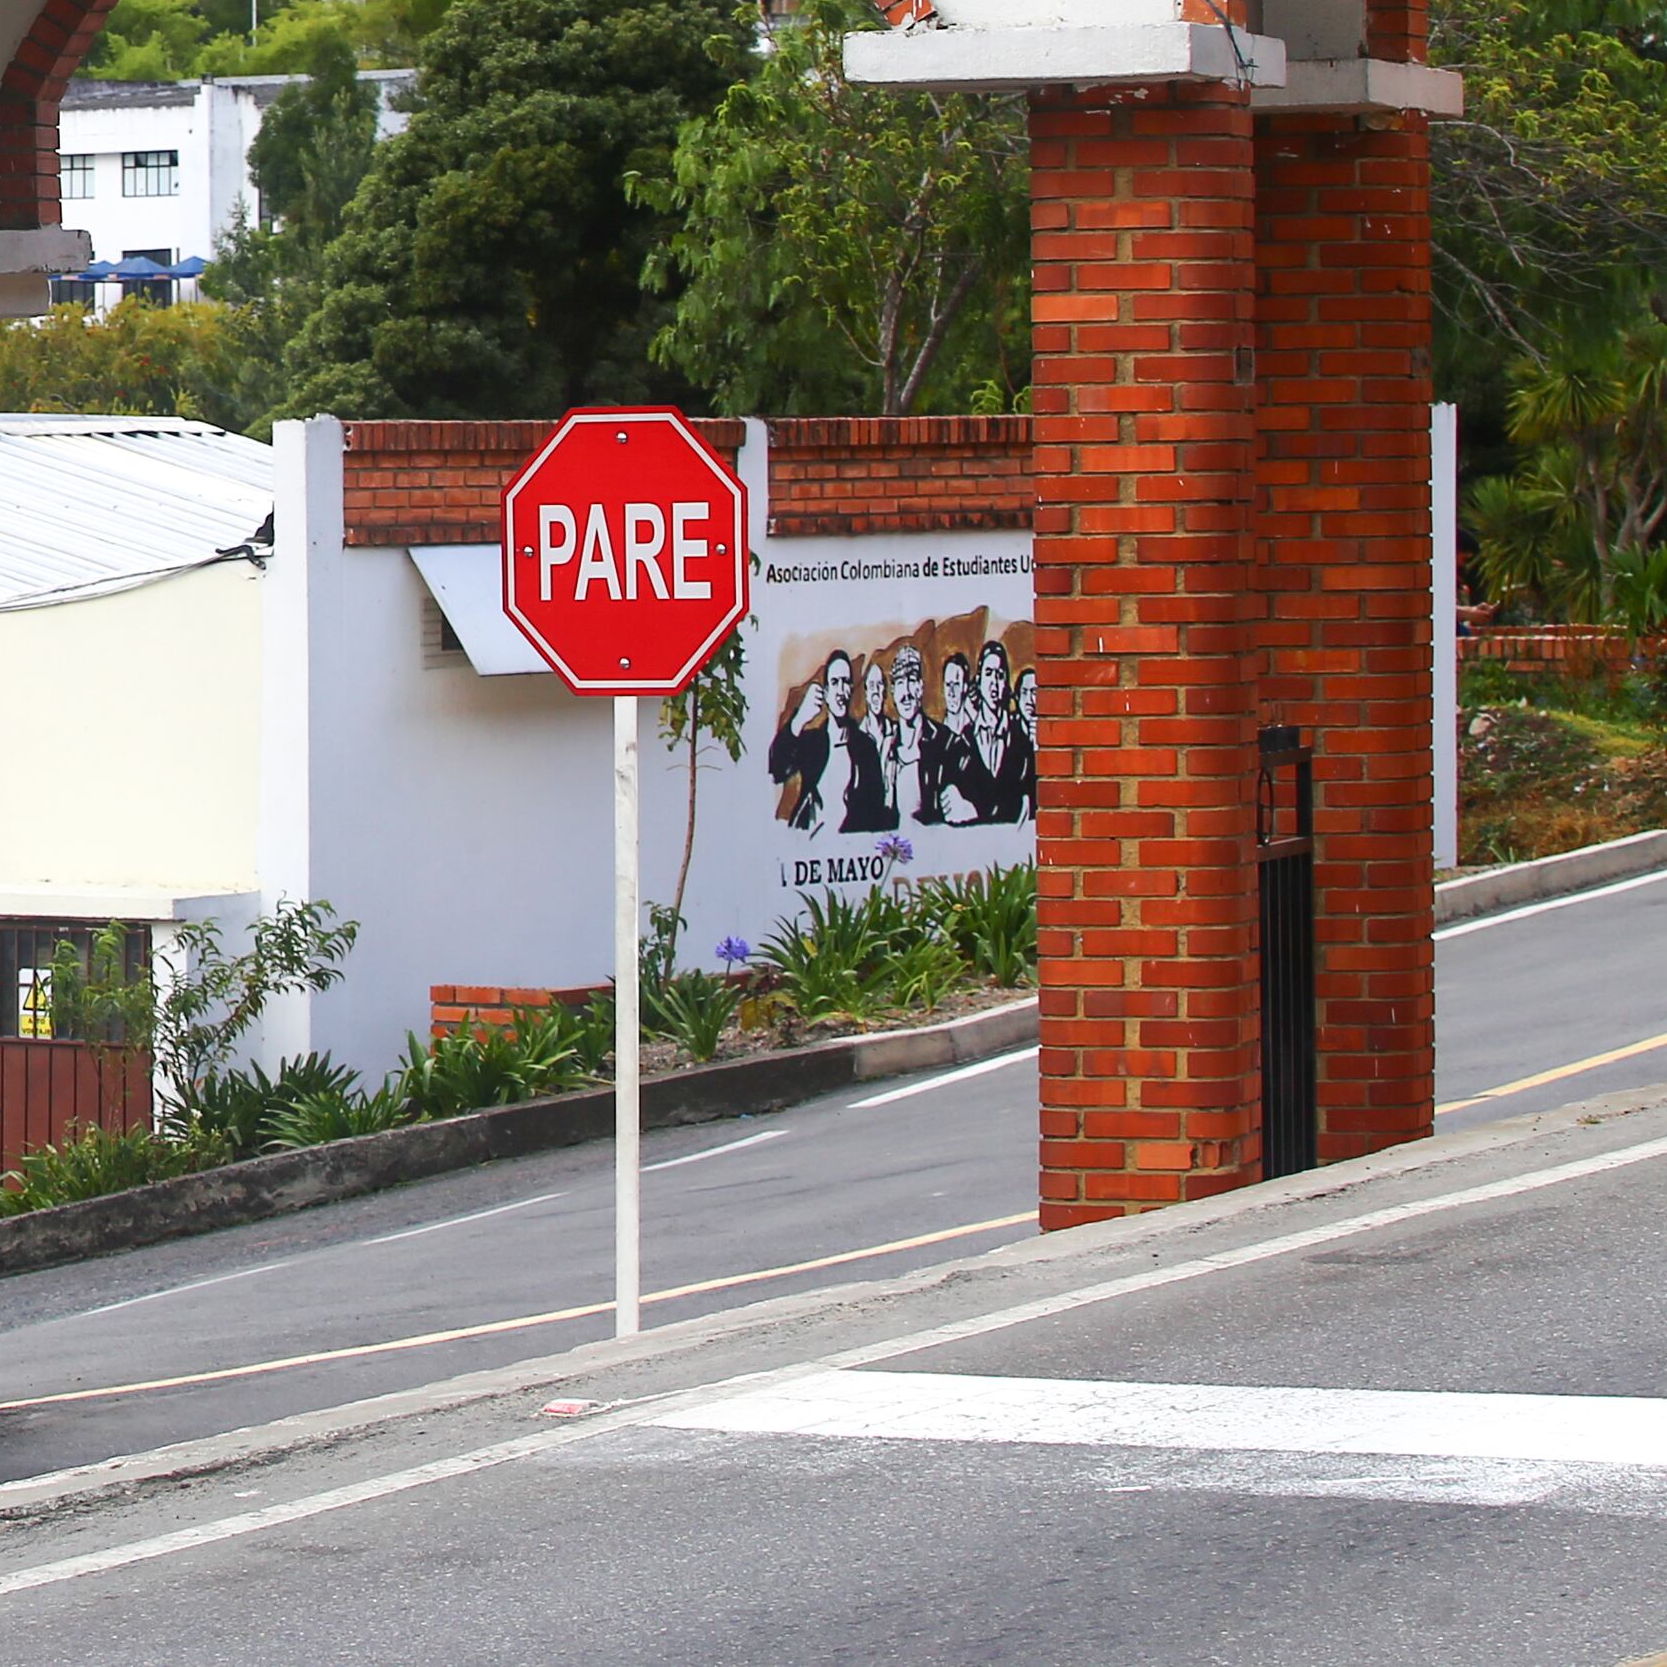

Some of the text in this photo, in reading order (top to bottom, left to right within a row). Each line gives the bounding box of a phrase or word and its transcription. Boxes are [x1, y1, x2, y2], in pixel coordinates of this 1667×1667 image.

[538, 502, 712, 602] PARE
[767, 554, 1034, 583] Asociación Colombiana de Estudiantes U
[795, 860, 821, 886] DE
[827, 855, 884, 884] MAYO
